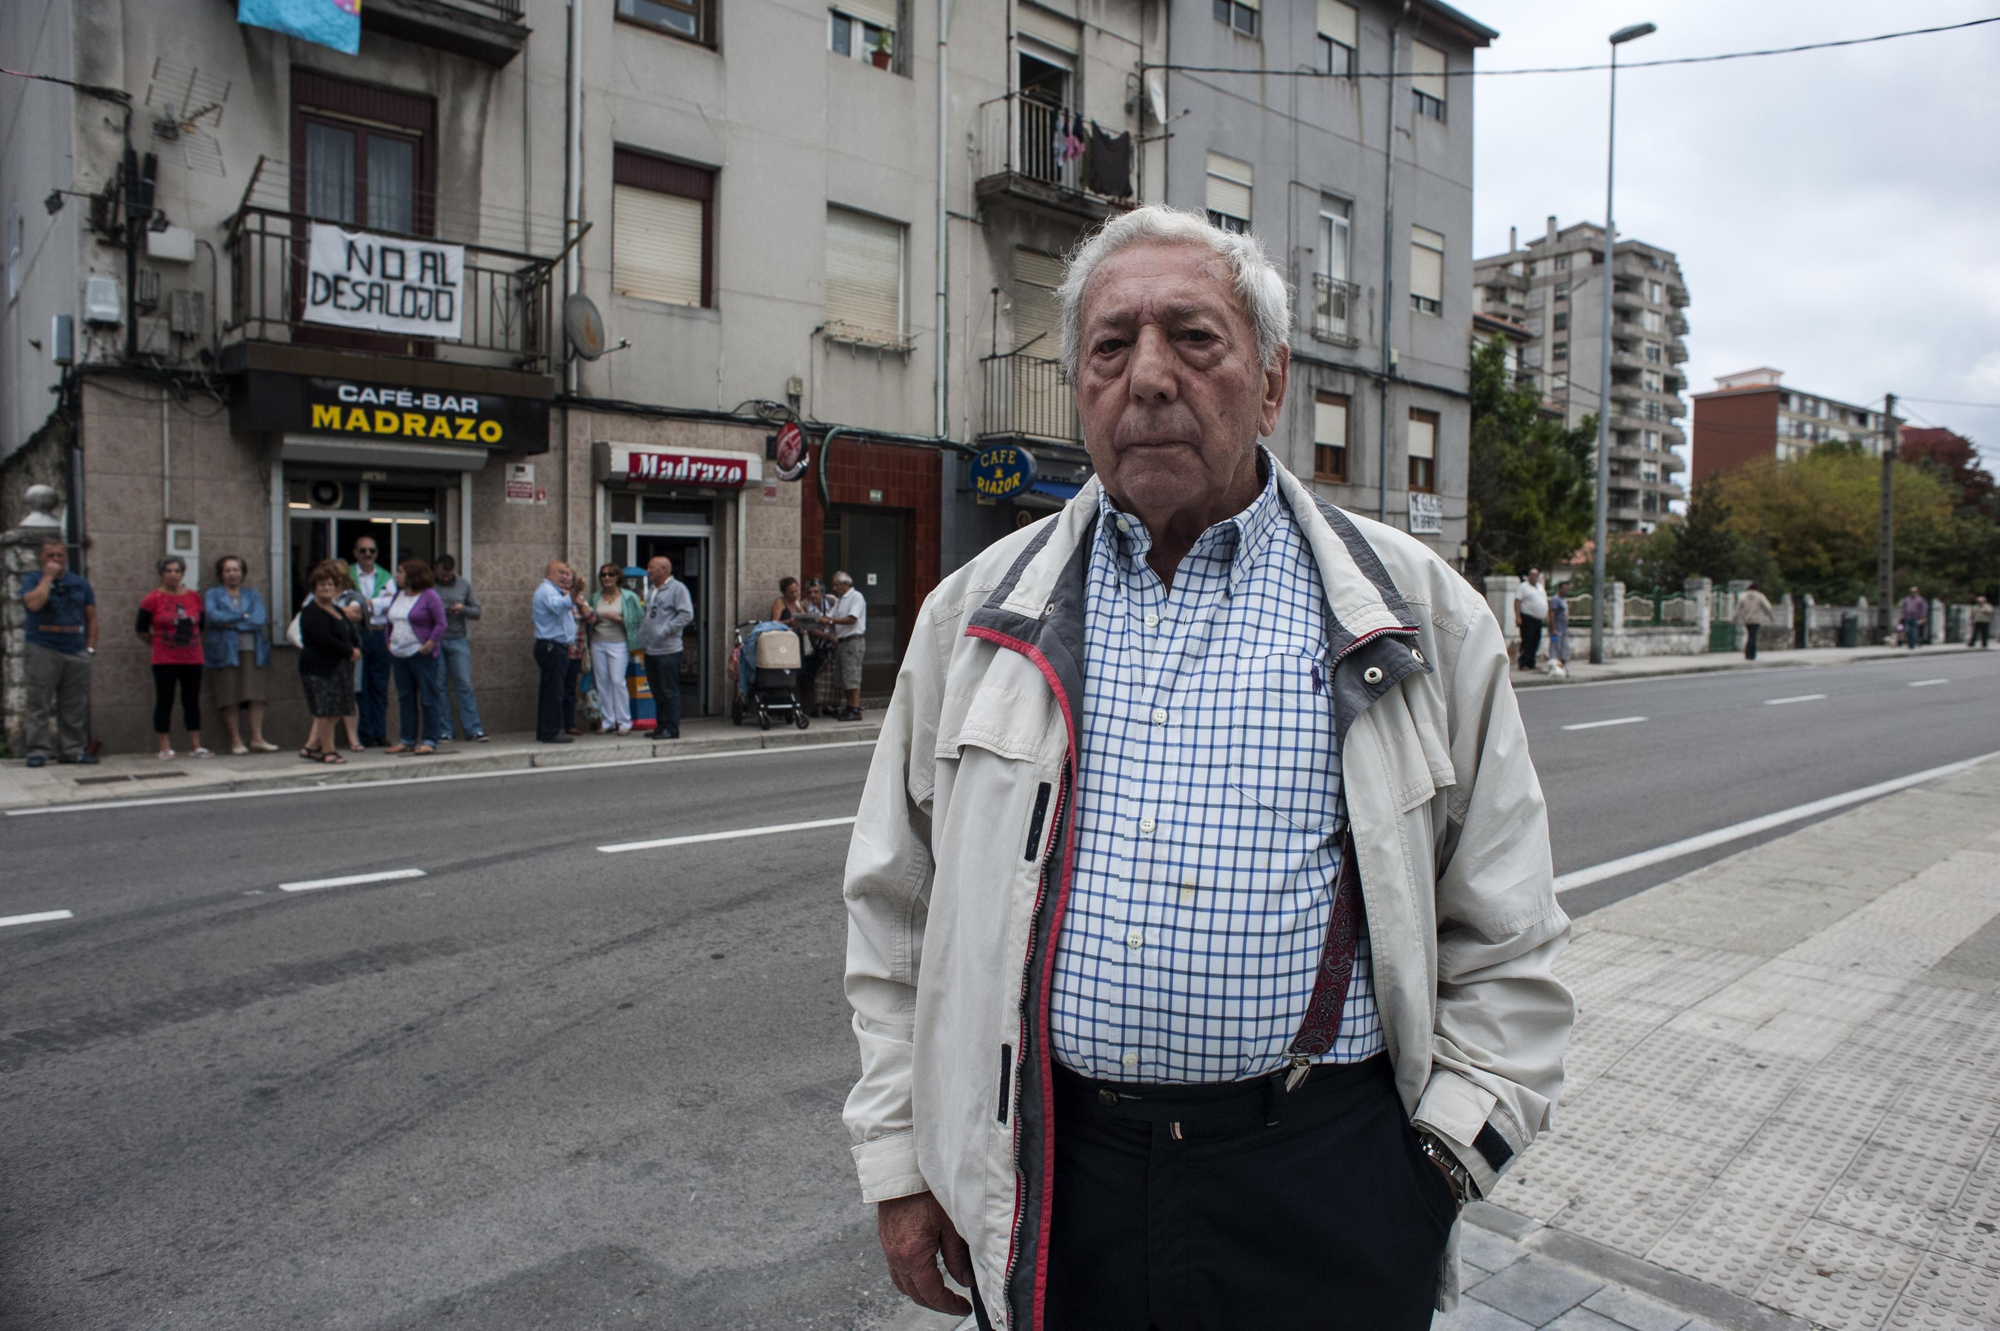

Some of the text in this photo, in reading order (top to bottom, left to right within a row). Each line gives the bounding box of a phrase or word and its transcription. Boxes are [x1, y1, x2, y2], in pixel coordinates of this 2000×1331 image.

[346, 240, 457, 287] NO AL
[311, 271, 453, 322] DESALOJO
[337, 385, 479, 414] CAFÉ-BAR
[311, 404, 503, 443] MADRAZO
[629, 454, 742, 483] Madrazo
[980, 449, 1017, 467] CAFE
[977, 471, 1021, 494] RIAZOR
